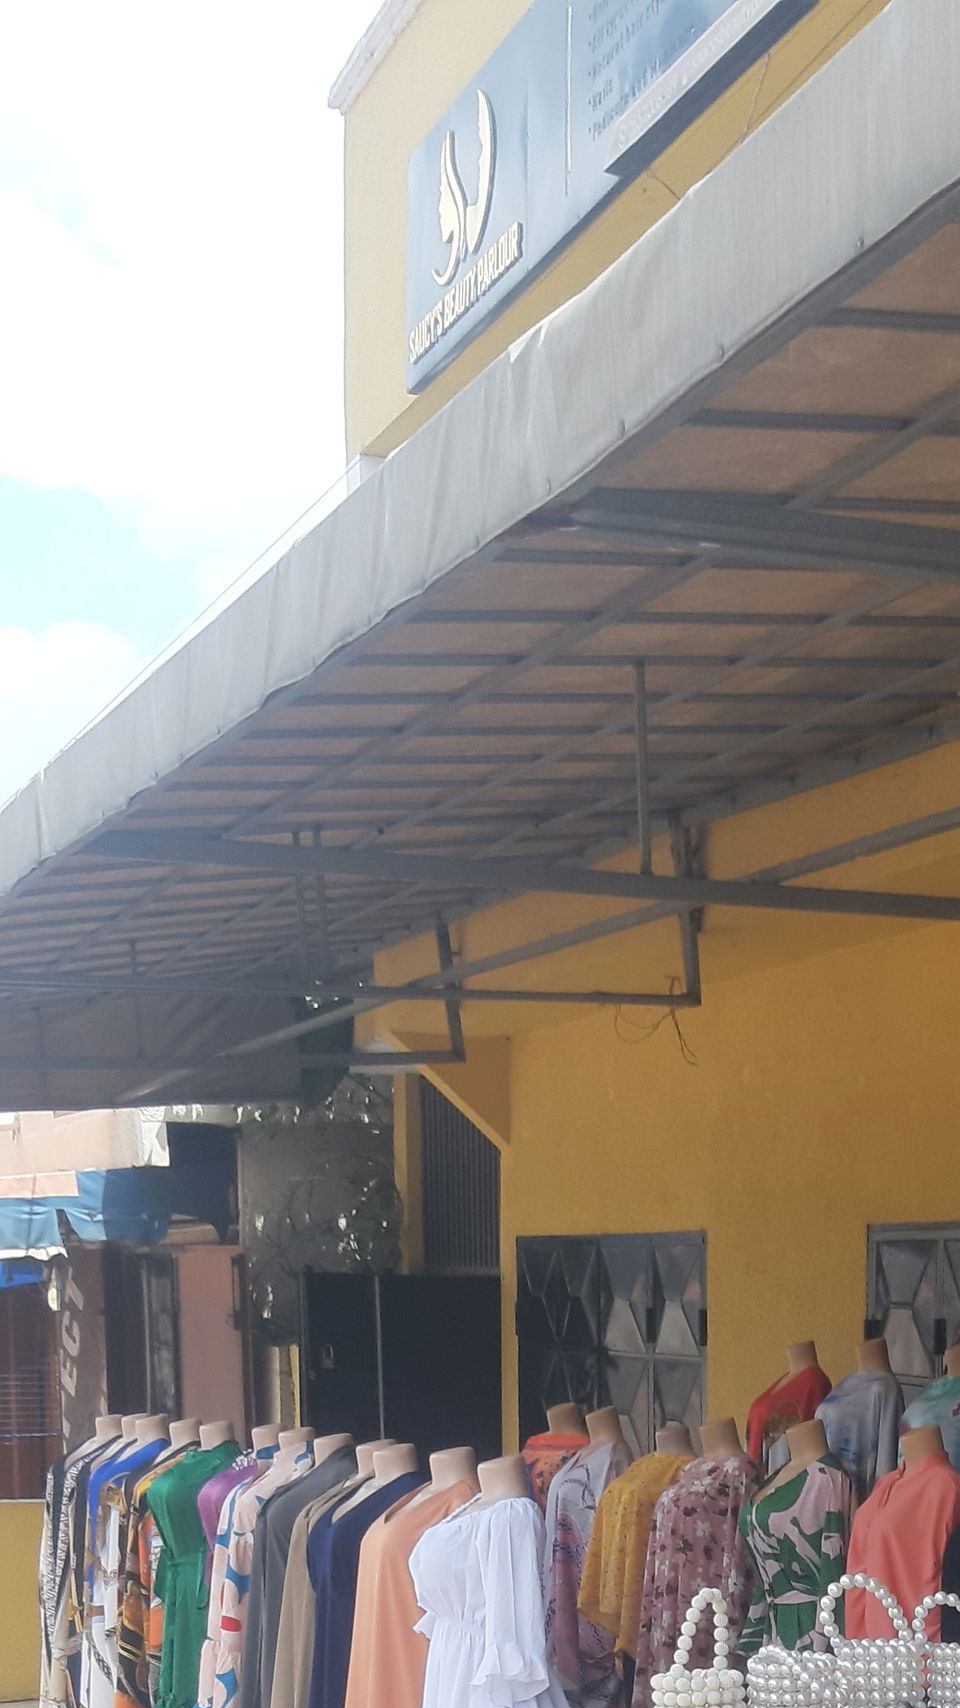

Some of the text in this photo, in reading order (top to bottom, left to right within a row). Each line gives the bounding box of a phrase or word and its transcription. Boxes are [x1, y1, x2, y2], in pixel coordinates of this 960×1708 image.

[408, 221, 522, 364] SAUCY'S BEAUTY PARLOUR
